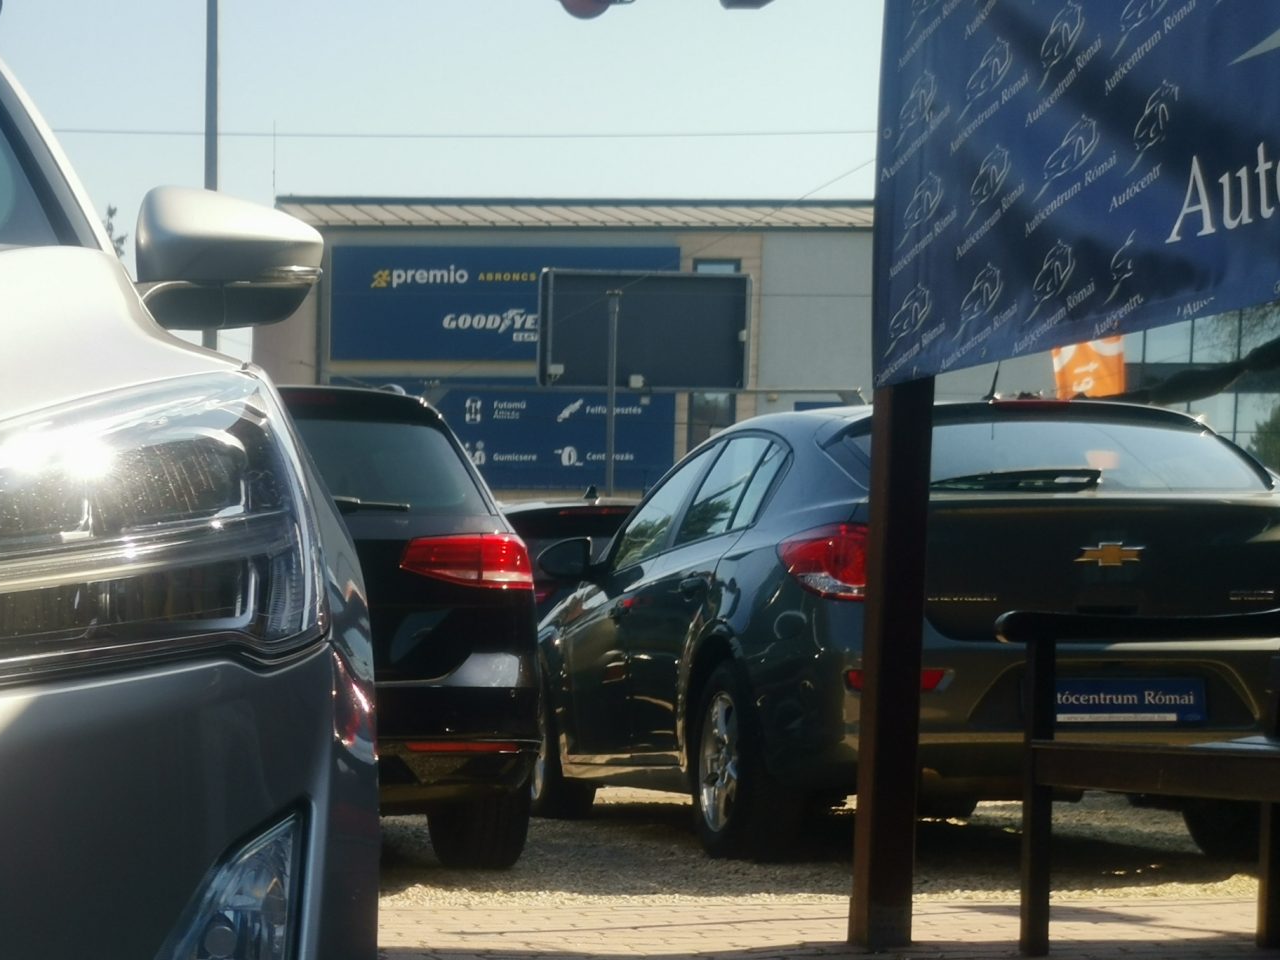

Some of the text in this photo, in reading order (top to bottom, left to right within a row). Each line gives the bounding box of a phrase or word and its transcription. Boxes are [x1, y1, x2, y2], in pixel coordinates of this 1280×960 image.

[1025, 33, 1102, 128] Autócentrum Római
[1105, 30, 1161, 96] Autócentrum
[1025, 151, 1117, 239] Autócentrum Római
[1165, 142, 1280, 243] Aut
[392, 264, 537, 289] premio ABRONCS
[493, 452, 538, 462] Gumicsere
[586, 451, 634, 461] Centrozás
[1143, 690, 1195, 705] Római
